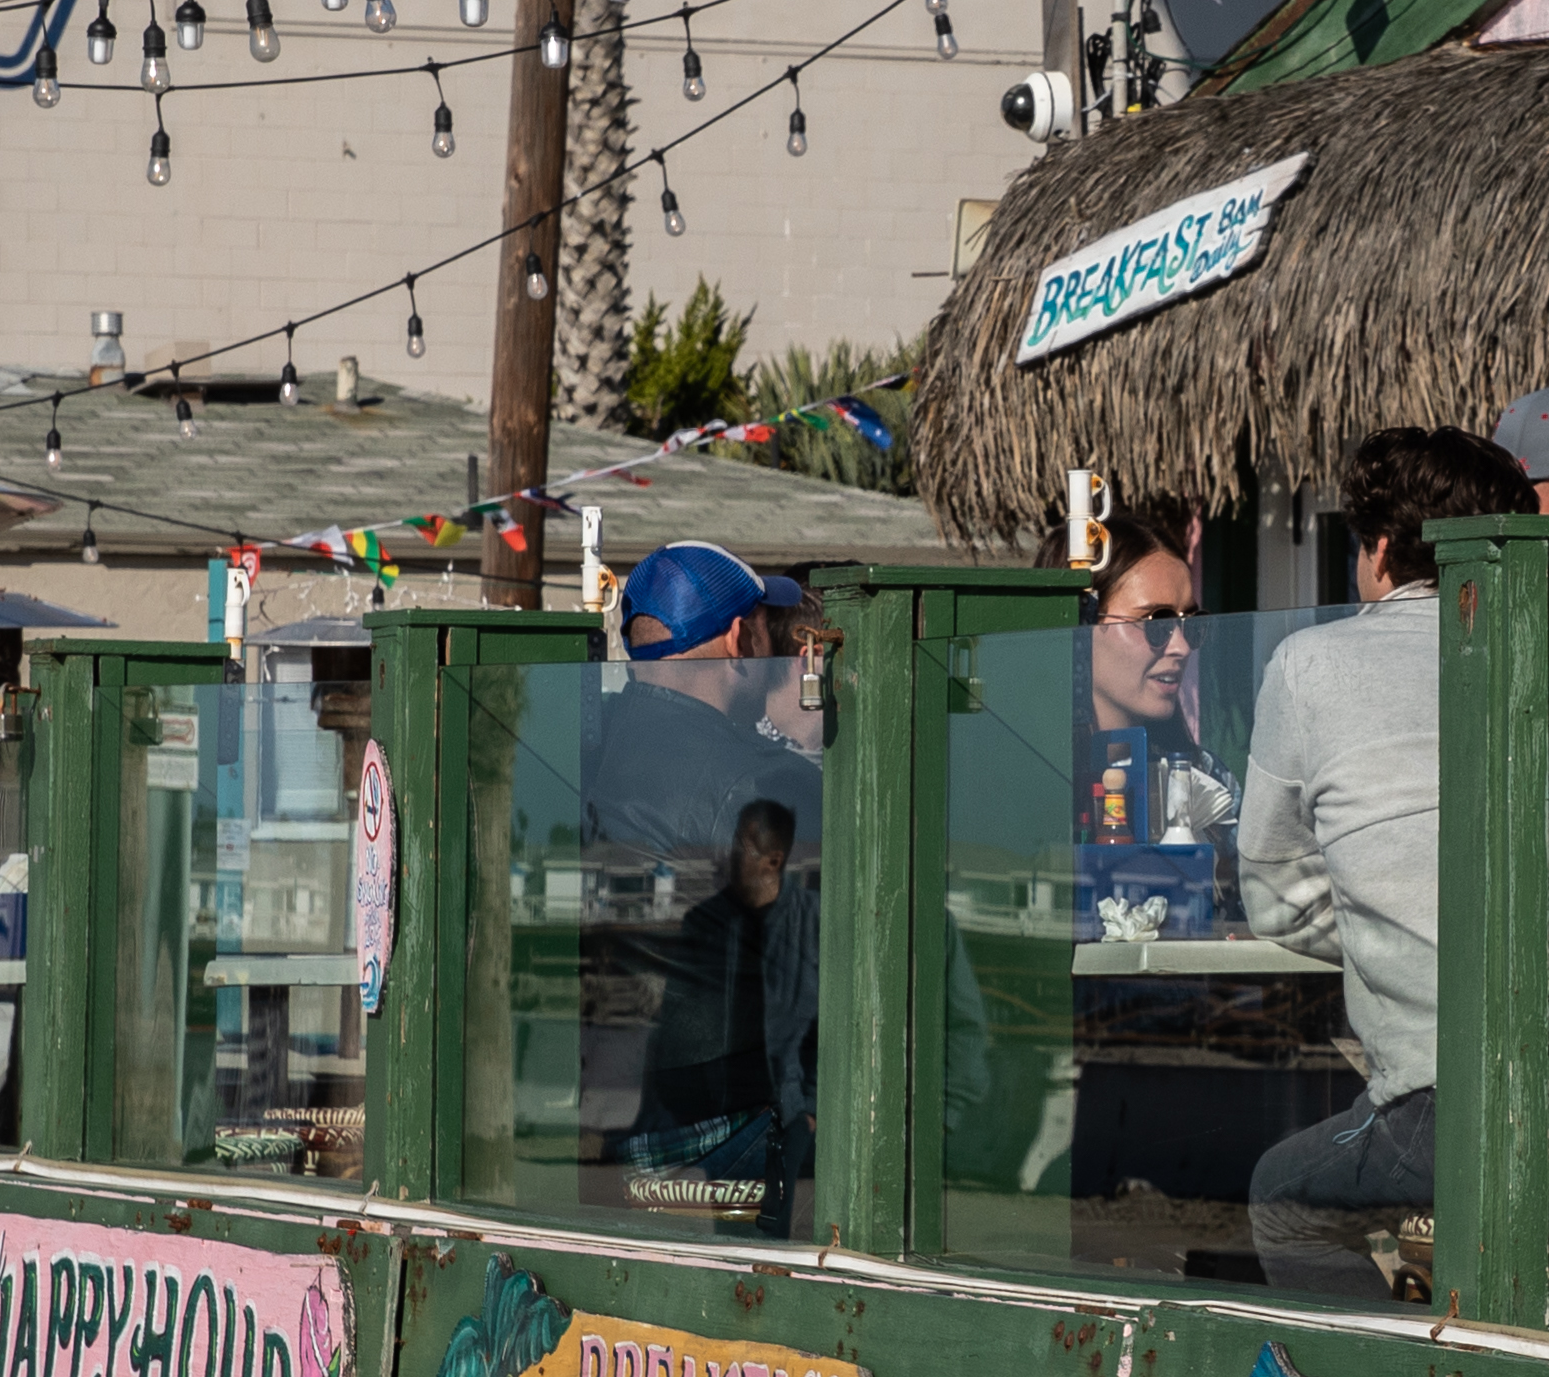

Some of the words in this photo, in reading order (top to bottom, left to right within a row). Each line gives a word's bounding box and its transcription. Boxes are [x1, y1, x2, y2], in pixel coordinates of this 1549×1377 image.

[1027, 211, 1214, 347] BREAKFAST
[1218, 189, 1264, 236] 8AM
[1190, 229, 1255, 285] Daily
